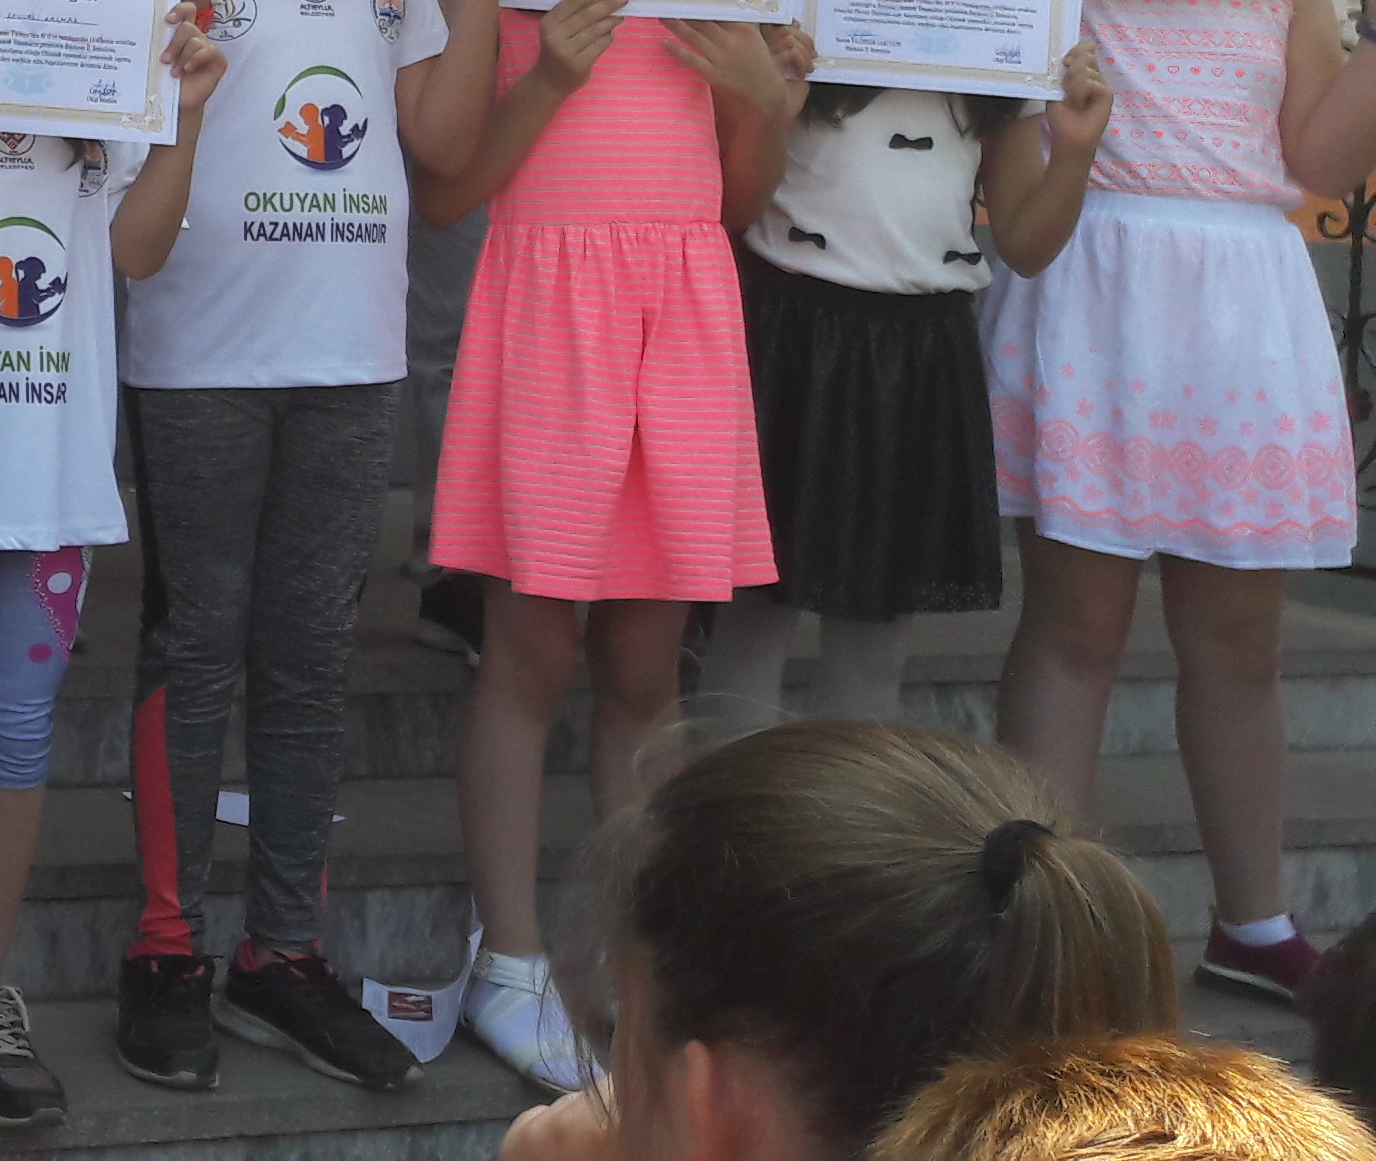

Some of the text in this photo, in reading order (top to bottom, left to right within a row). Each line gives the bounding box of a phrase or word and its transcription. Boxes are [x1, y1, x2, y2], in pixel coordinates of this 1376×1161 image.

[244, 187, 387, 215] OKUYAN İNSAN
[243, 217, 387, 244] KAZANAN İNSANDIR
